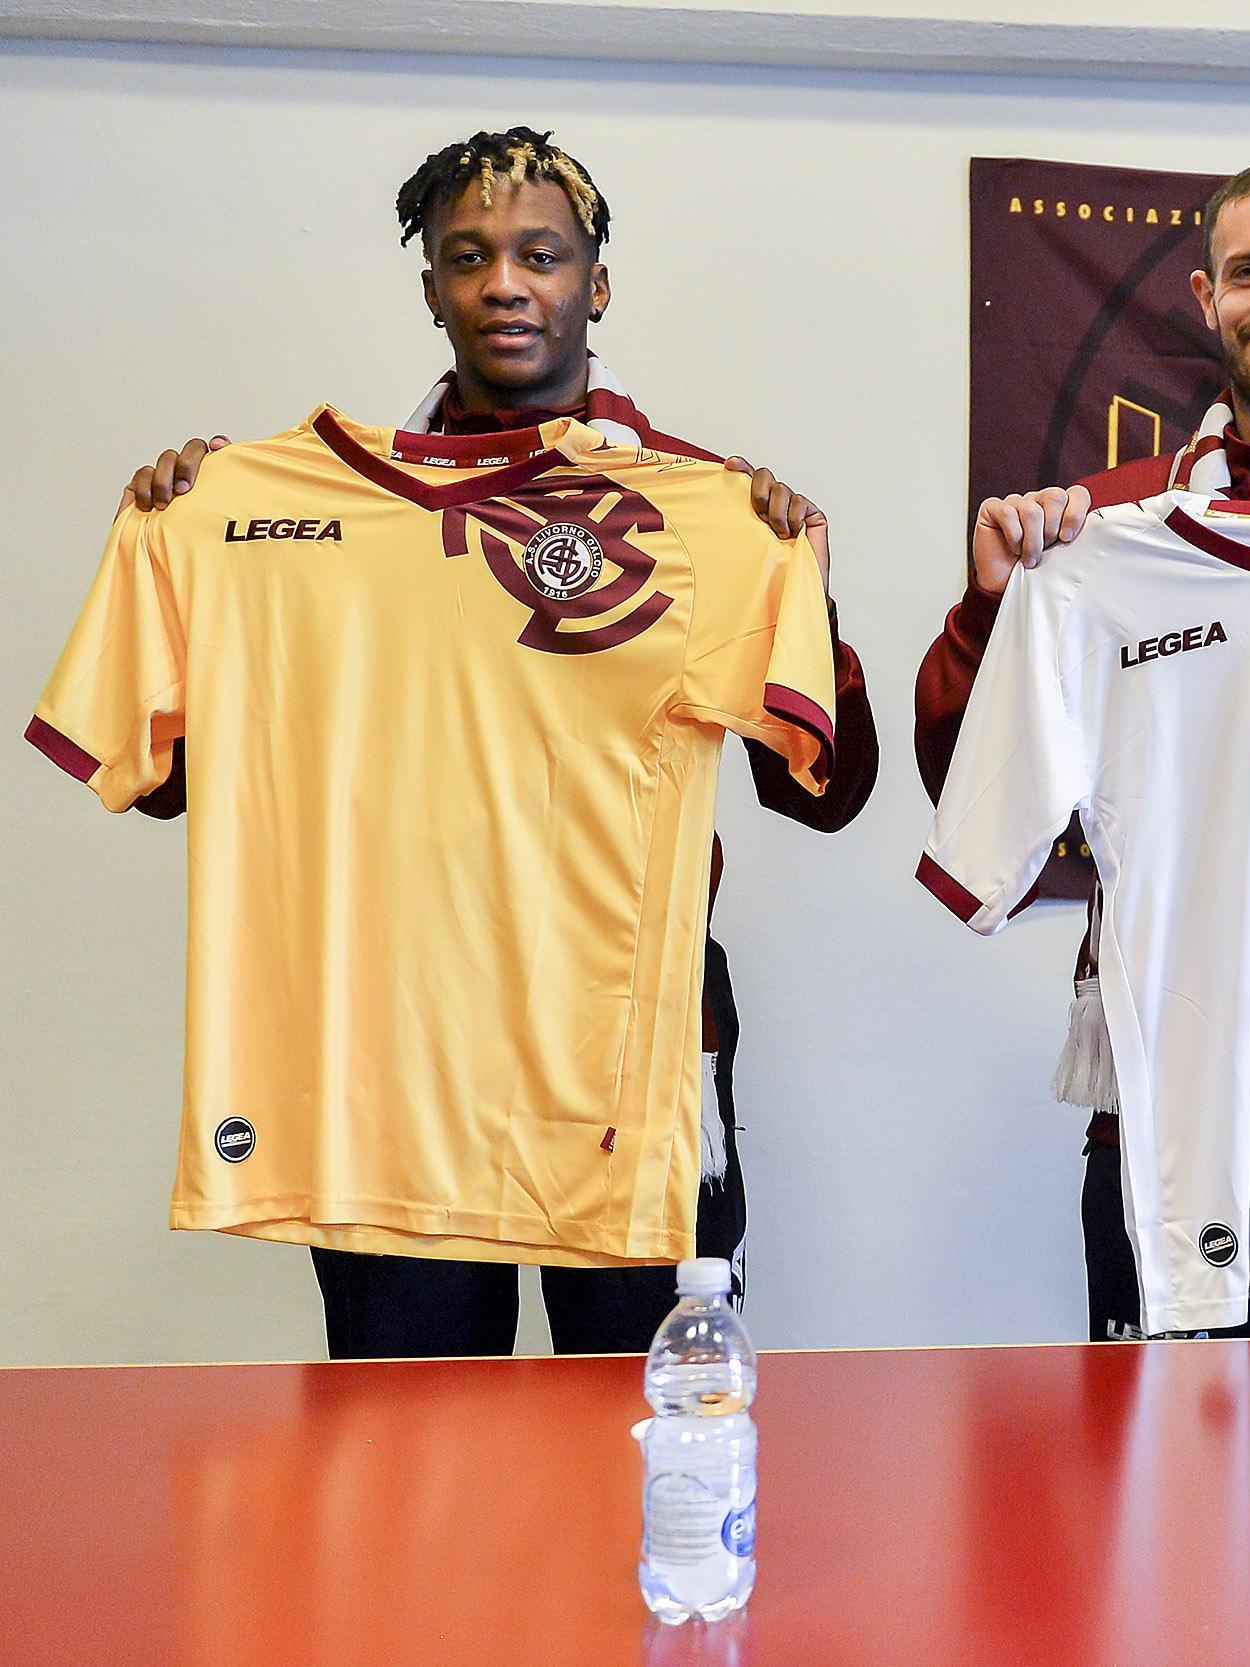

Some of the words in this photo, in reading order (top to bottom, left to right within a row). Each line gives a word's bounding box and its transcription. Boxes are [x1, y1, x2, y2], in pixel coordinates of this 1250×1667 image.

[1008, 197, 1202, 226] ASSOCIAZI
[423, 456, 457, 468] LEGEA
[476, 456, 510, 467] LEGEA
[224, 518, 343, 543] LEGEA
[535, 525, 585, 543] LIVORNO
[586, 538, 602, 578] CALCIO
[1121, 621, 1227, 669] LEGEA
[220, 1131, 251, 1144] LEGEA
[1203, 1235, 1233, 1250] LEGEA
